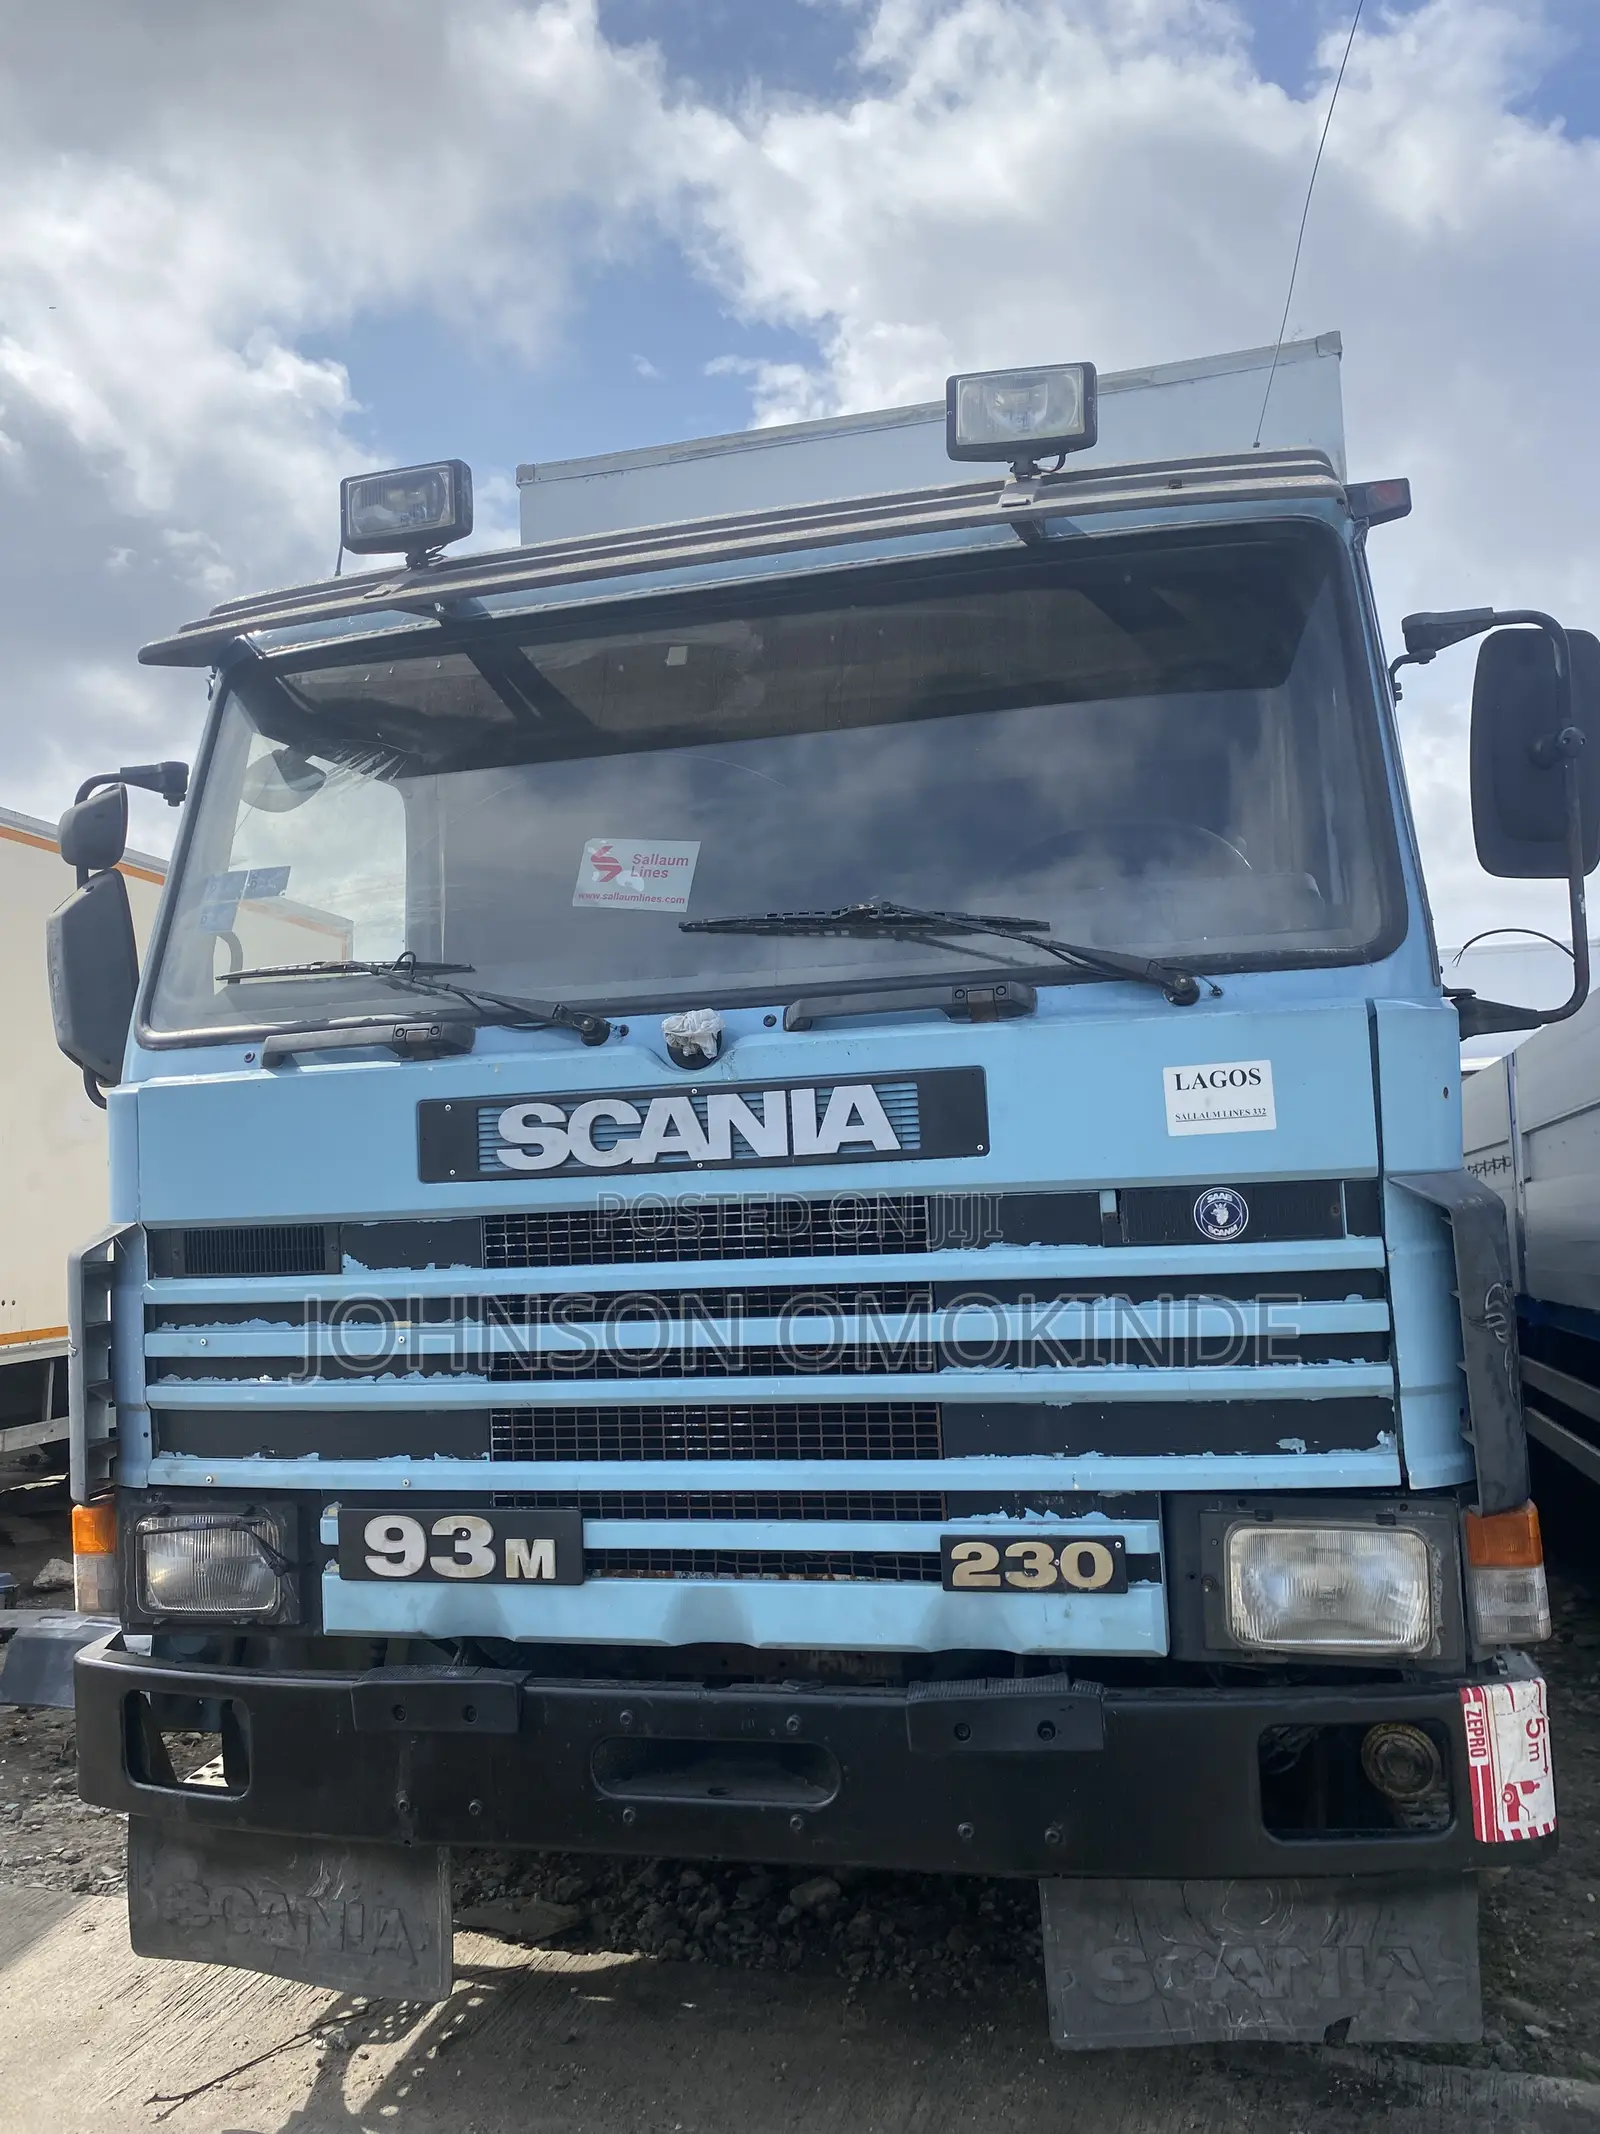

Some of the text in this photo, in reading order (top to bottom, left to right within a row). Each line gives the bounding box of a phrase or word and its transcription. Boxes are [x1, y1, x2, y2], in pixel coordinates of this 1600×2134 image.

[631, 853, 689, 867] Sallaum
[630, 866, 669, 879] Lines
[578, 891, 686, 905] www.sallaumlines.com
[1174, 1067, 1262, 1091] LAGOS
[1175, 1107, 1267, 1120] SALLAUM LINES 332
[496, 1084, 902, 1172] SCANIA
[1206, 1192, 1233, 1204] SAAB
[1207, 1223, 1238, 1237] SCANIA
[363, 1514, 557, 1580] 93 M
[950, 1541, 1114, 1589] 230
[1464, 1709, 1488, 1759] ZEPRO
[1090, 1943, 1436, 2005] SCANIA
